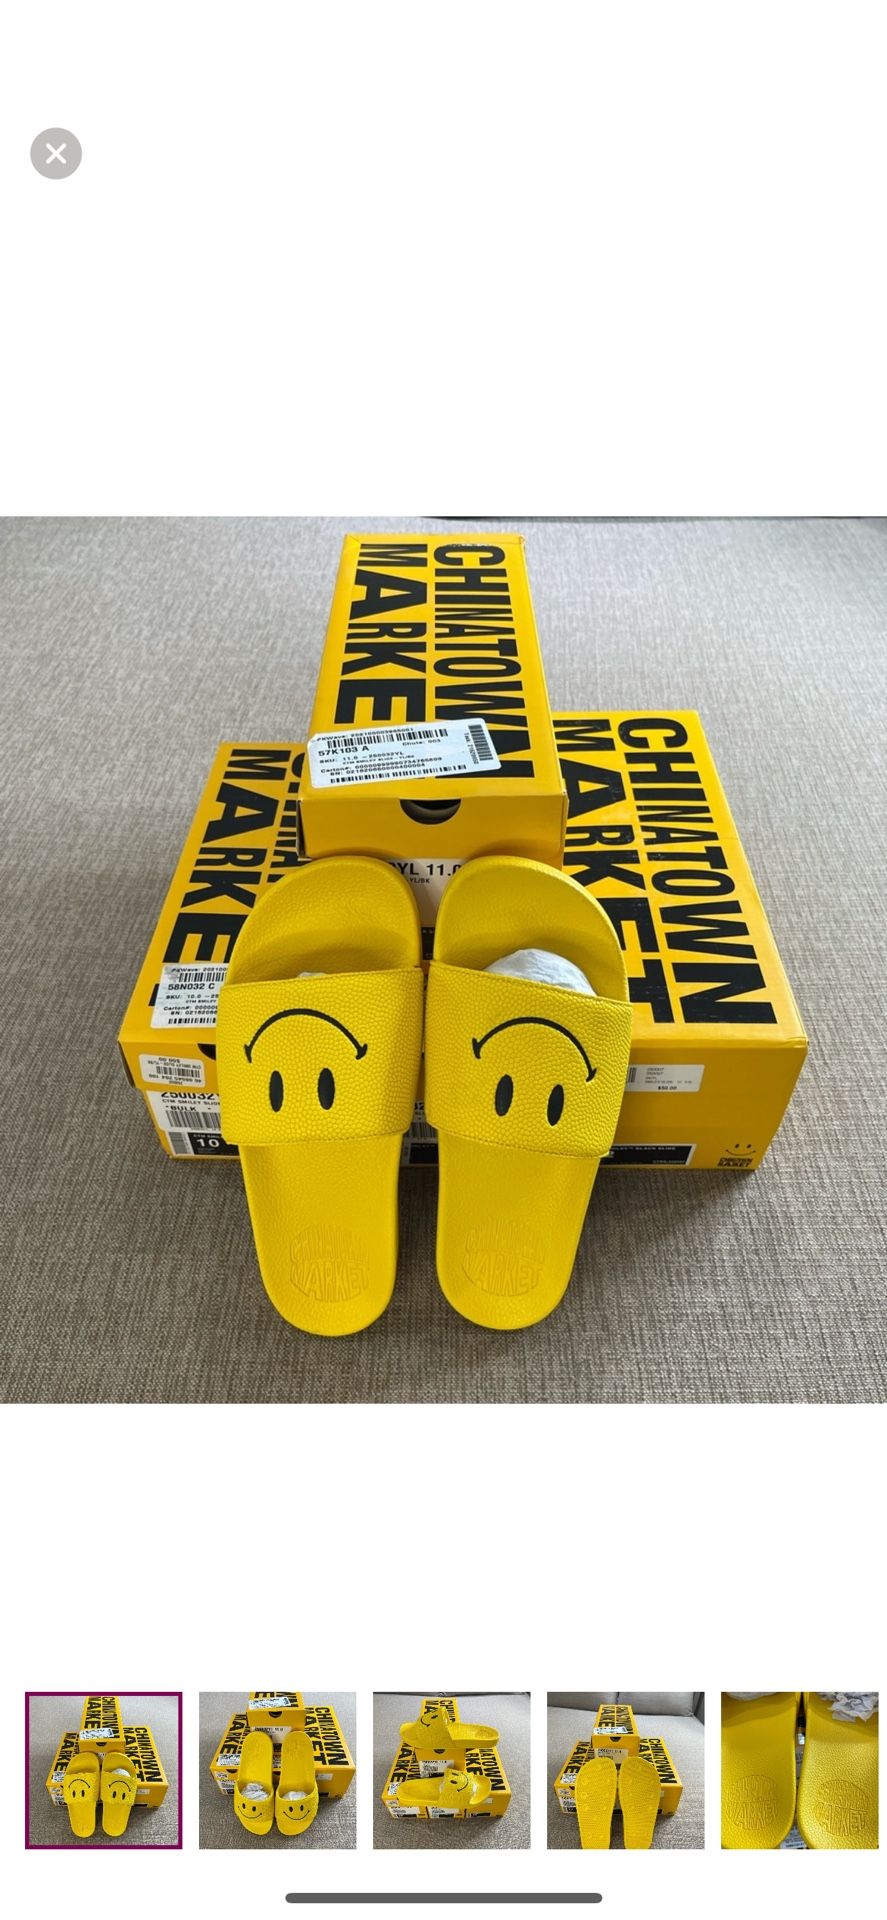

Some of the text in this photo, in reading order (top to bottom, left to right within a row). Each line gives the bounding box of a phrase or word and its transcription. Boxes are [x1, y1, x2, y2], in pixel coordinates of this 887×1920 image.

[318, 747, 358, 757] 57K103
[333, 543, 428, 778] MARKE
[433, 544, 535, 778] CHINATOWN
[147, 748, 292, 1006] MARKE
[552, 718, 676, 1024] MARKET
[617, 717, 778, 1025] CHINATOWN
[52, 1733, 77, 1779] MARKE
[217, 1713, 242, 1762] MARKE
